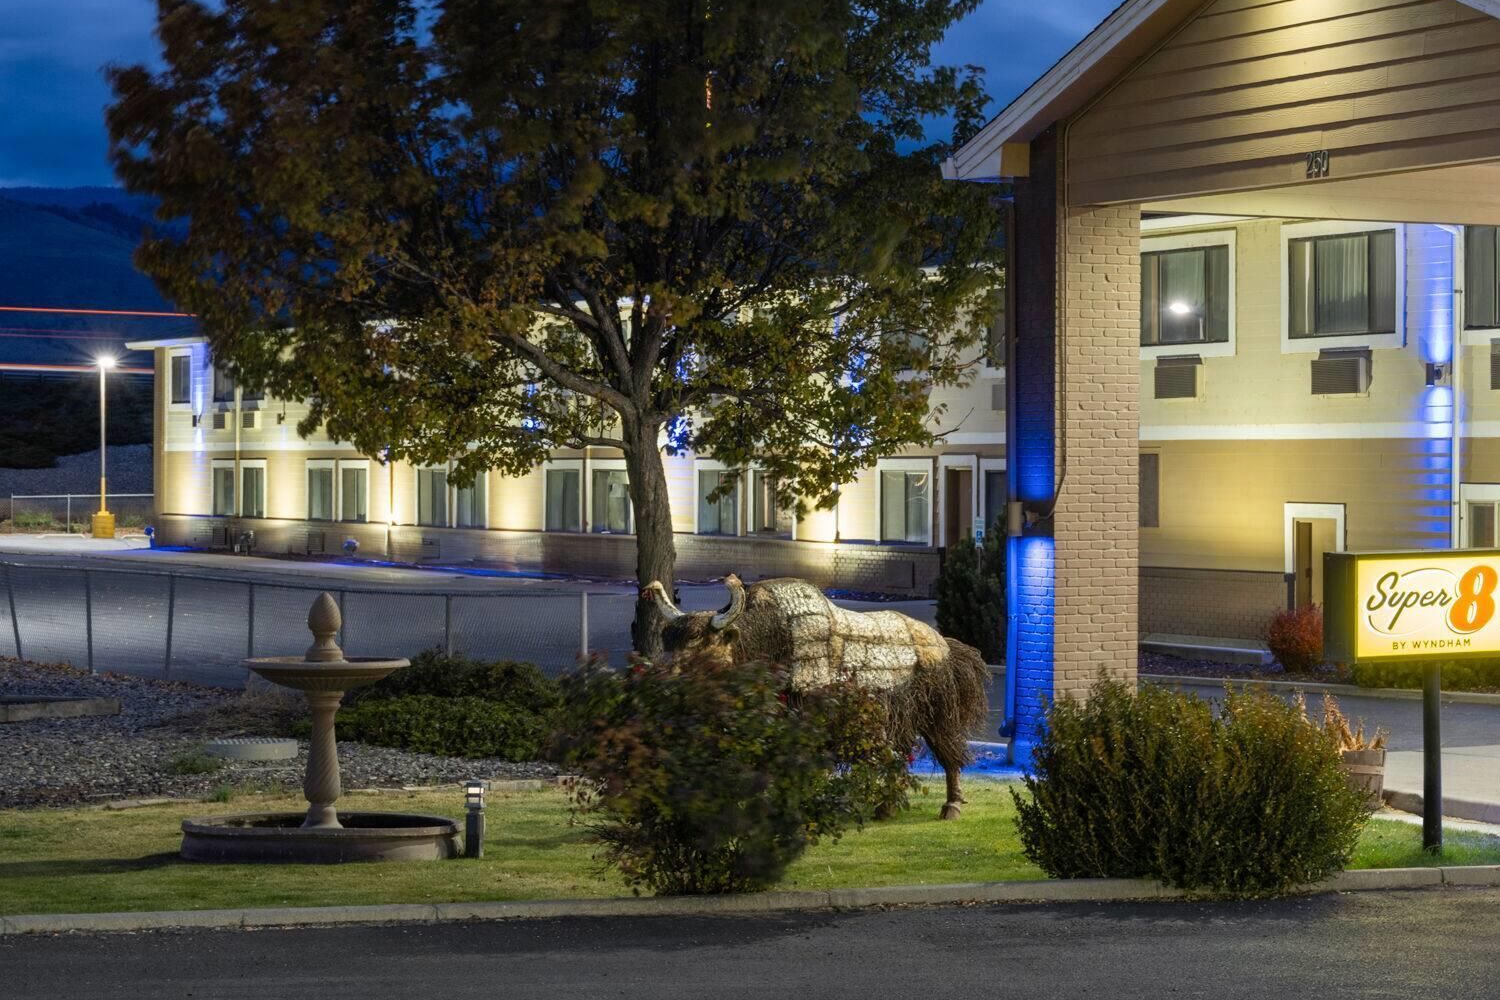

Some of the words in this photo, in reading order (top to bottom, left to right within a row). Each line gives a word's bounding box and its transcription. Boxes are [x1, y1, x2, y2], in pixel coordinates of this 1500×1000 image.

[1366, 571, 1453, 631] Super
[1449, 564, 1499, 632] 8
[1392, 641, 1406, 650] BY
[1412, 638, 1472, 649] WYNDHAM
